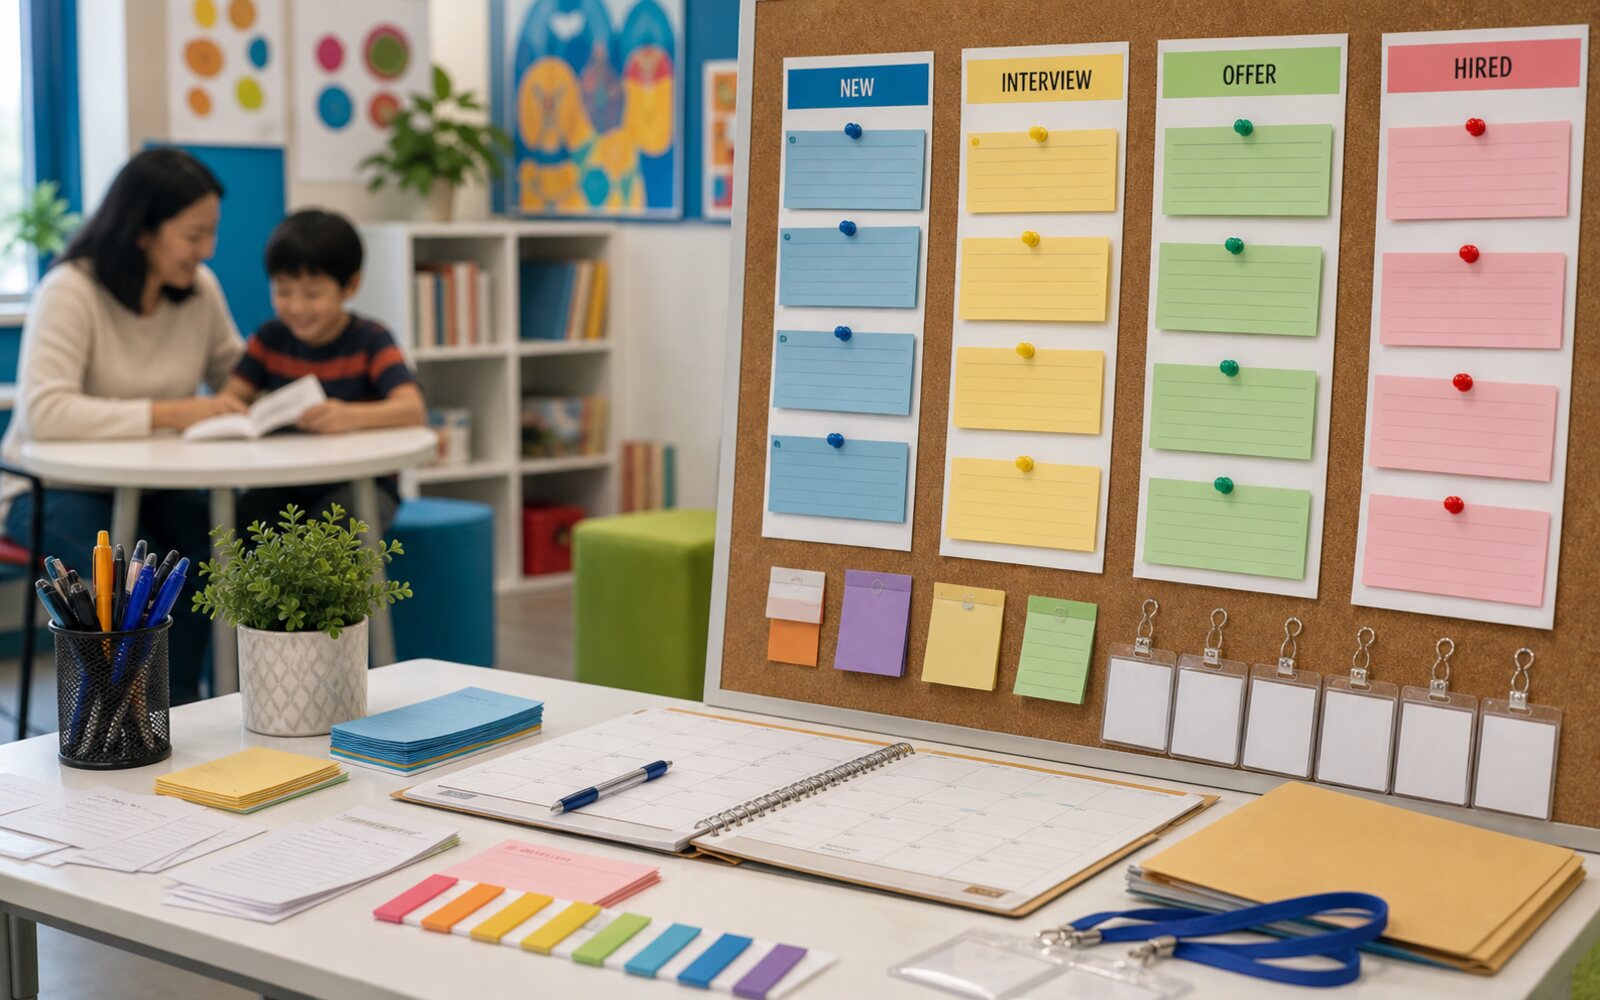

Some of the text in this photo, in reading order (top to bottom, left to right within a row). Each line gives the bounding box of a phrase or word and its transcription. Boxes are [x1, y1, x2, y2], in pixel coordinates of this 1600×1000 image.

[1223, 63, 1277, 85] OFFER
[1454, 56, 1512, 79] HIRED
[840, 78, 875, 98] NEW
[1002, 70, 1092, 92] INTERVIEW
